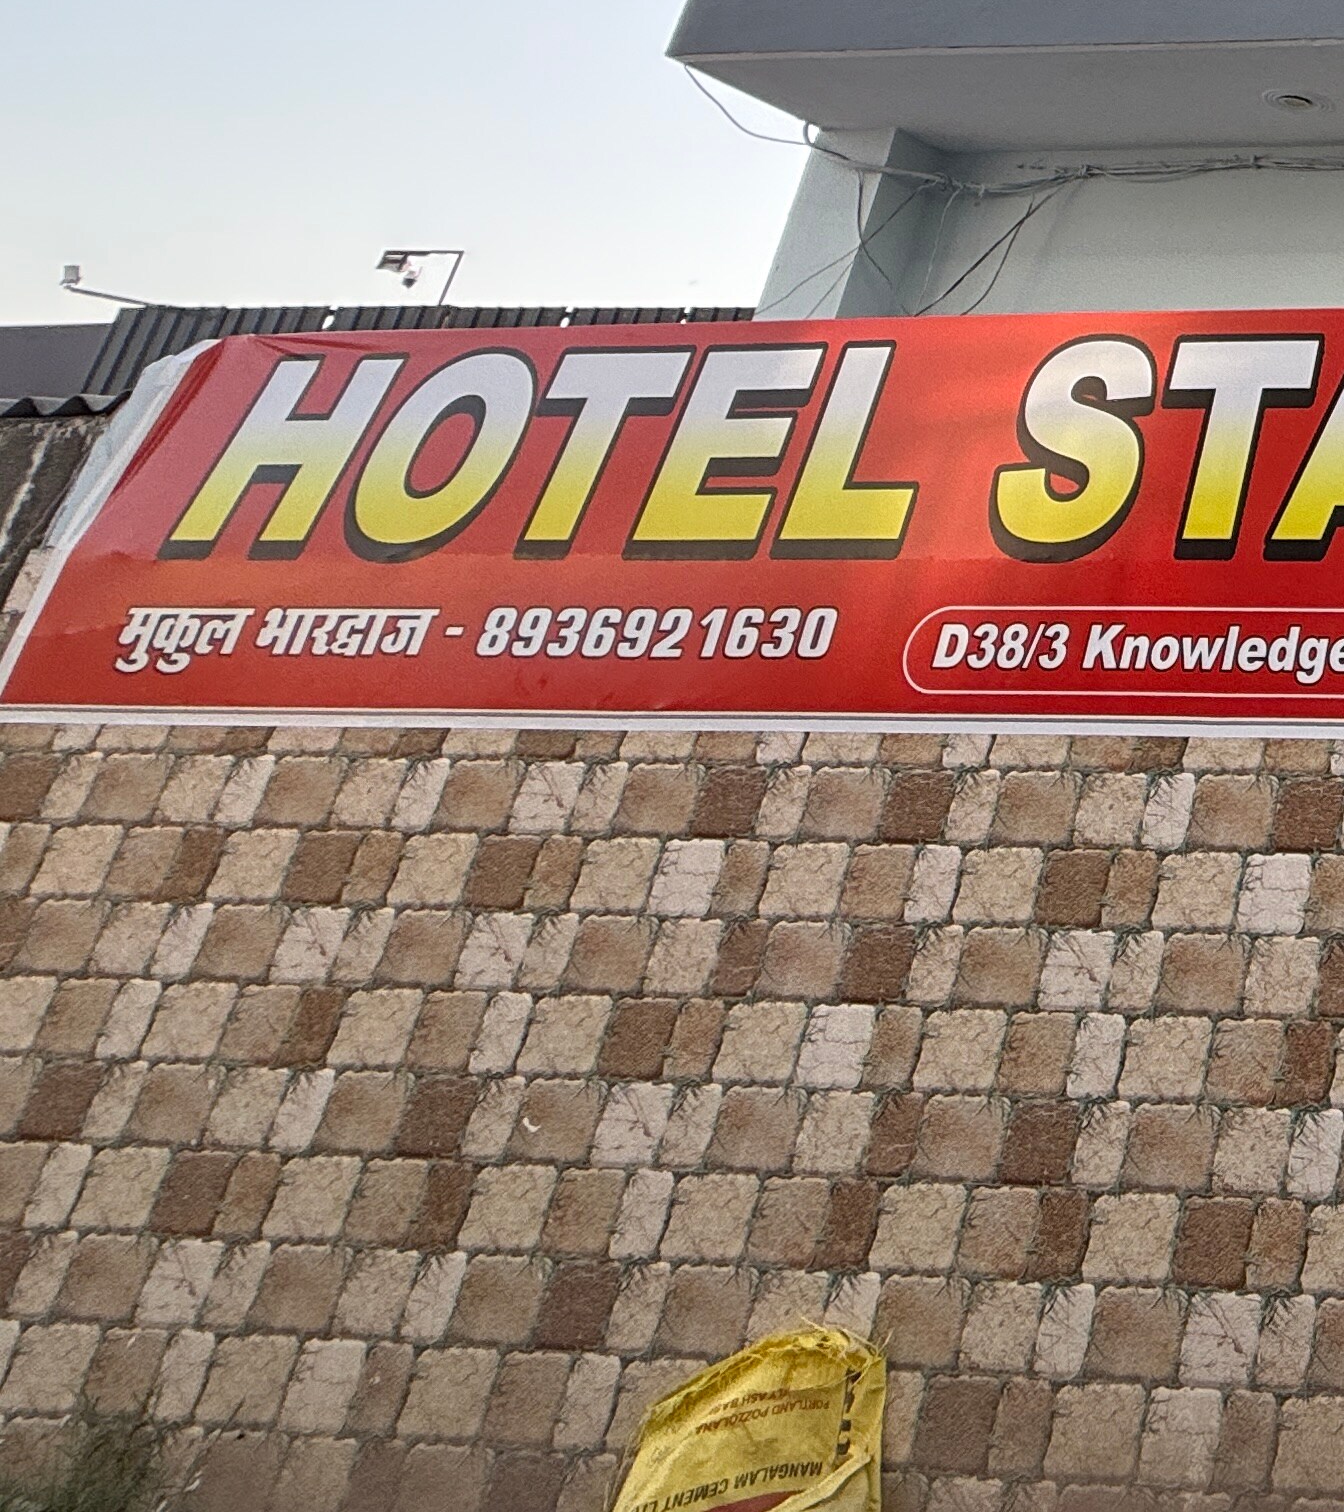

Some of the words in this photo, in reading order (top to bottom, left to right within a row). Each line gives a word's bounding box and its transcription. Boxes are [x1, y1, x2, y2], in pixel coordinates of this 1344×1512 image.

[158, 340, 919, 561] HOTEL
[114, 606, 256, 674] मुकुल
[255, 606, 441, 657] भारद्वाज
[475, 606, 840, 659] 8936921630
[930, 622, 1070, 670] D38/3
[771, 1399, 830, 1416] PORTLAND
[662, 1478, 729, 1511] CEMENT
[733, 1461, 823, 1489] MANGALAM
